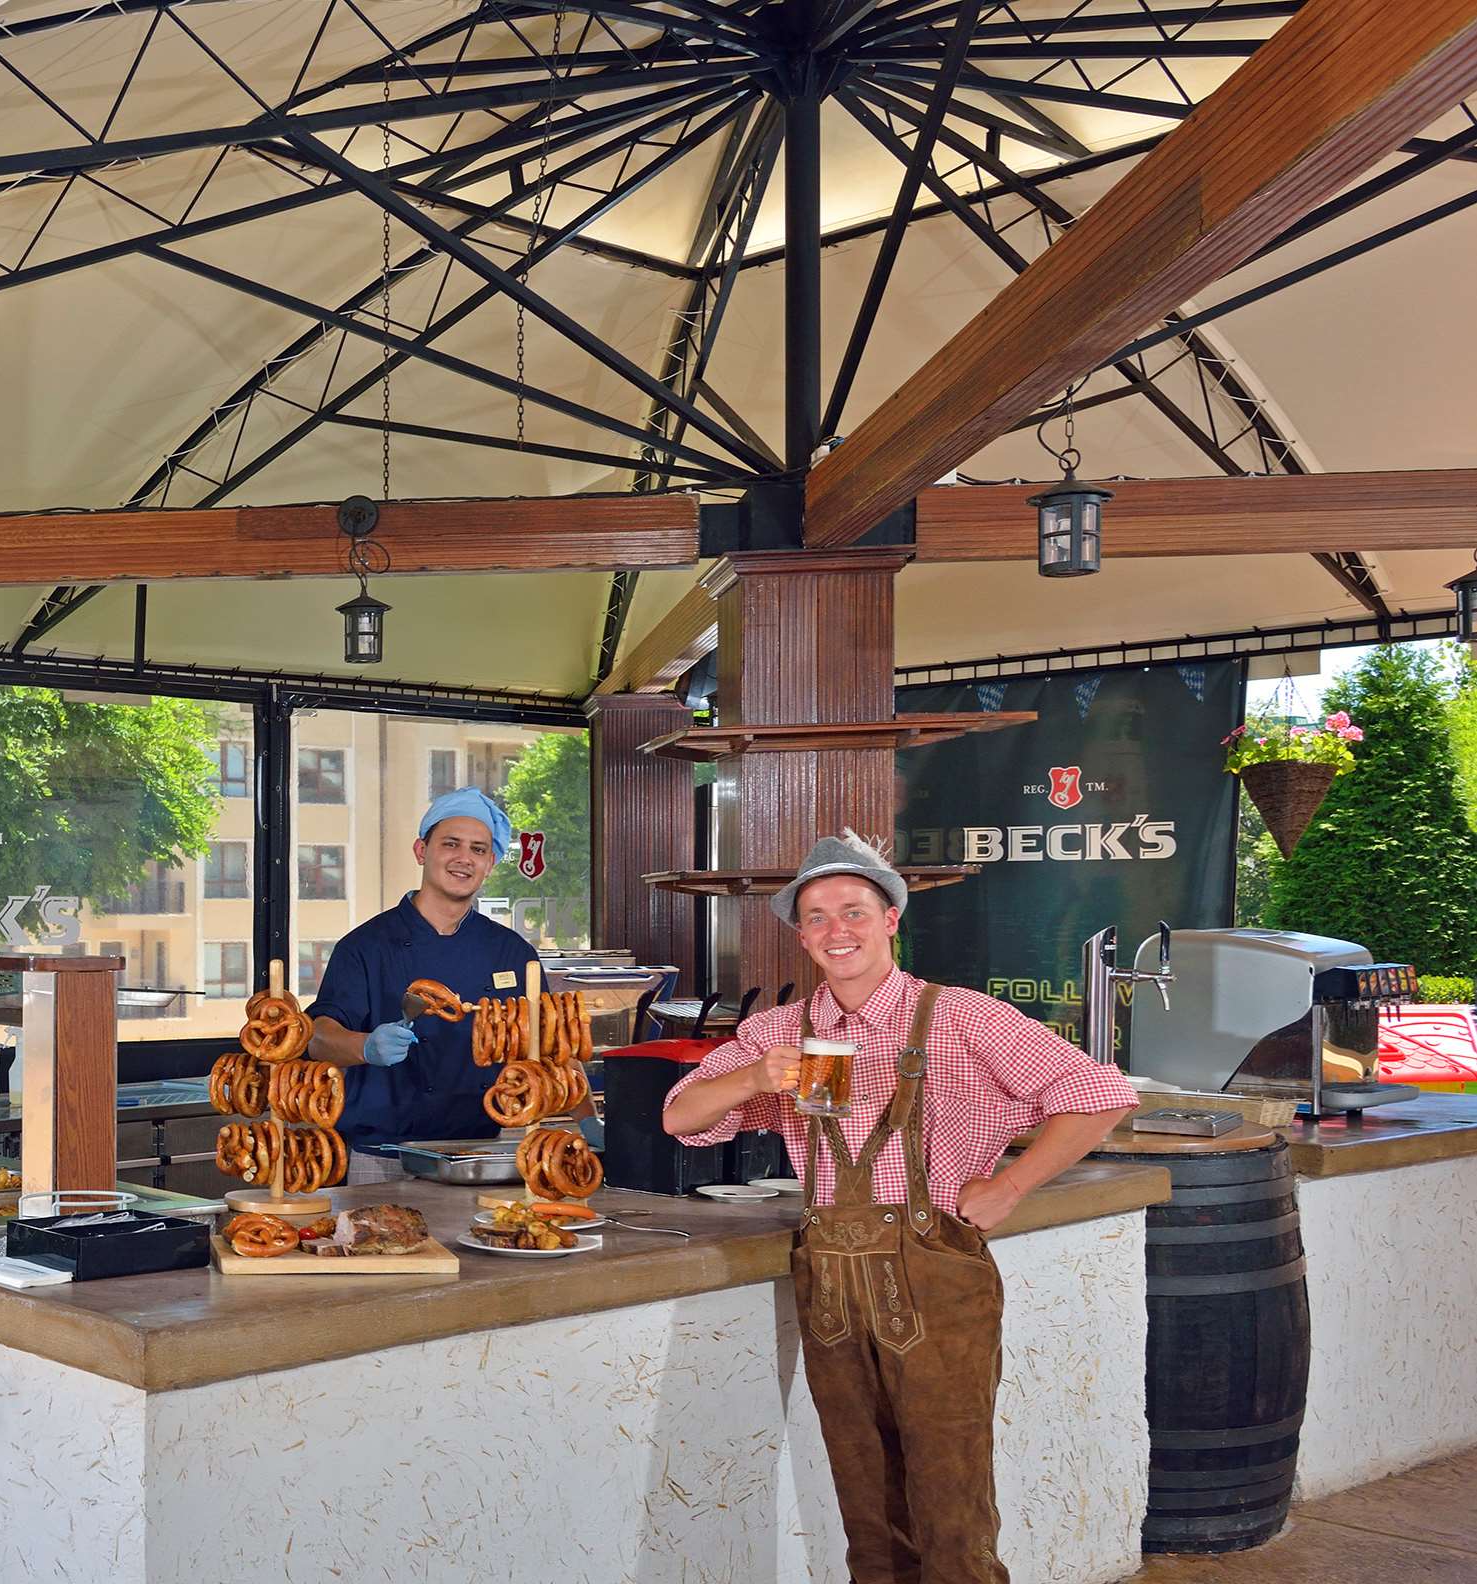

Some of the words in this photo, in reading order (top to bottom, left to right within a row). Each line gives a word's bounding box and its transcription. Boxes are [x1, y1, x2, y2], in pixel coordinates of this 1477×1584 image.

[1023, 784, 1048, 795] REG.
[1086, 782, 1108, 793] TM.
[963, 814, 1177, 862] BECK'S
